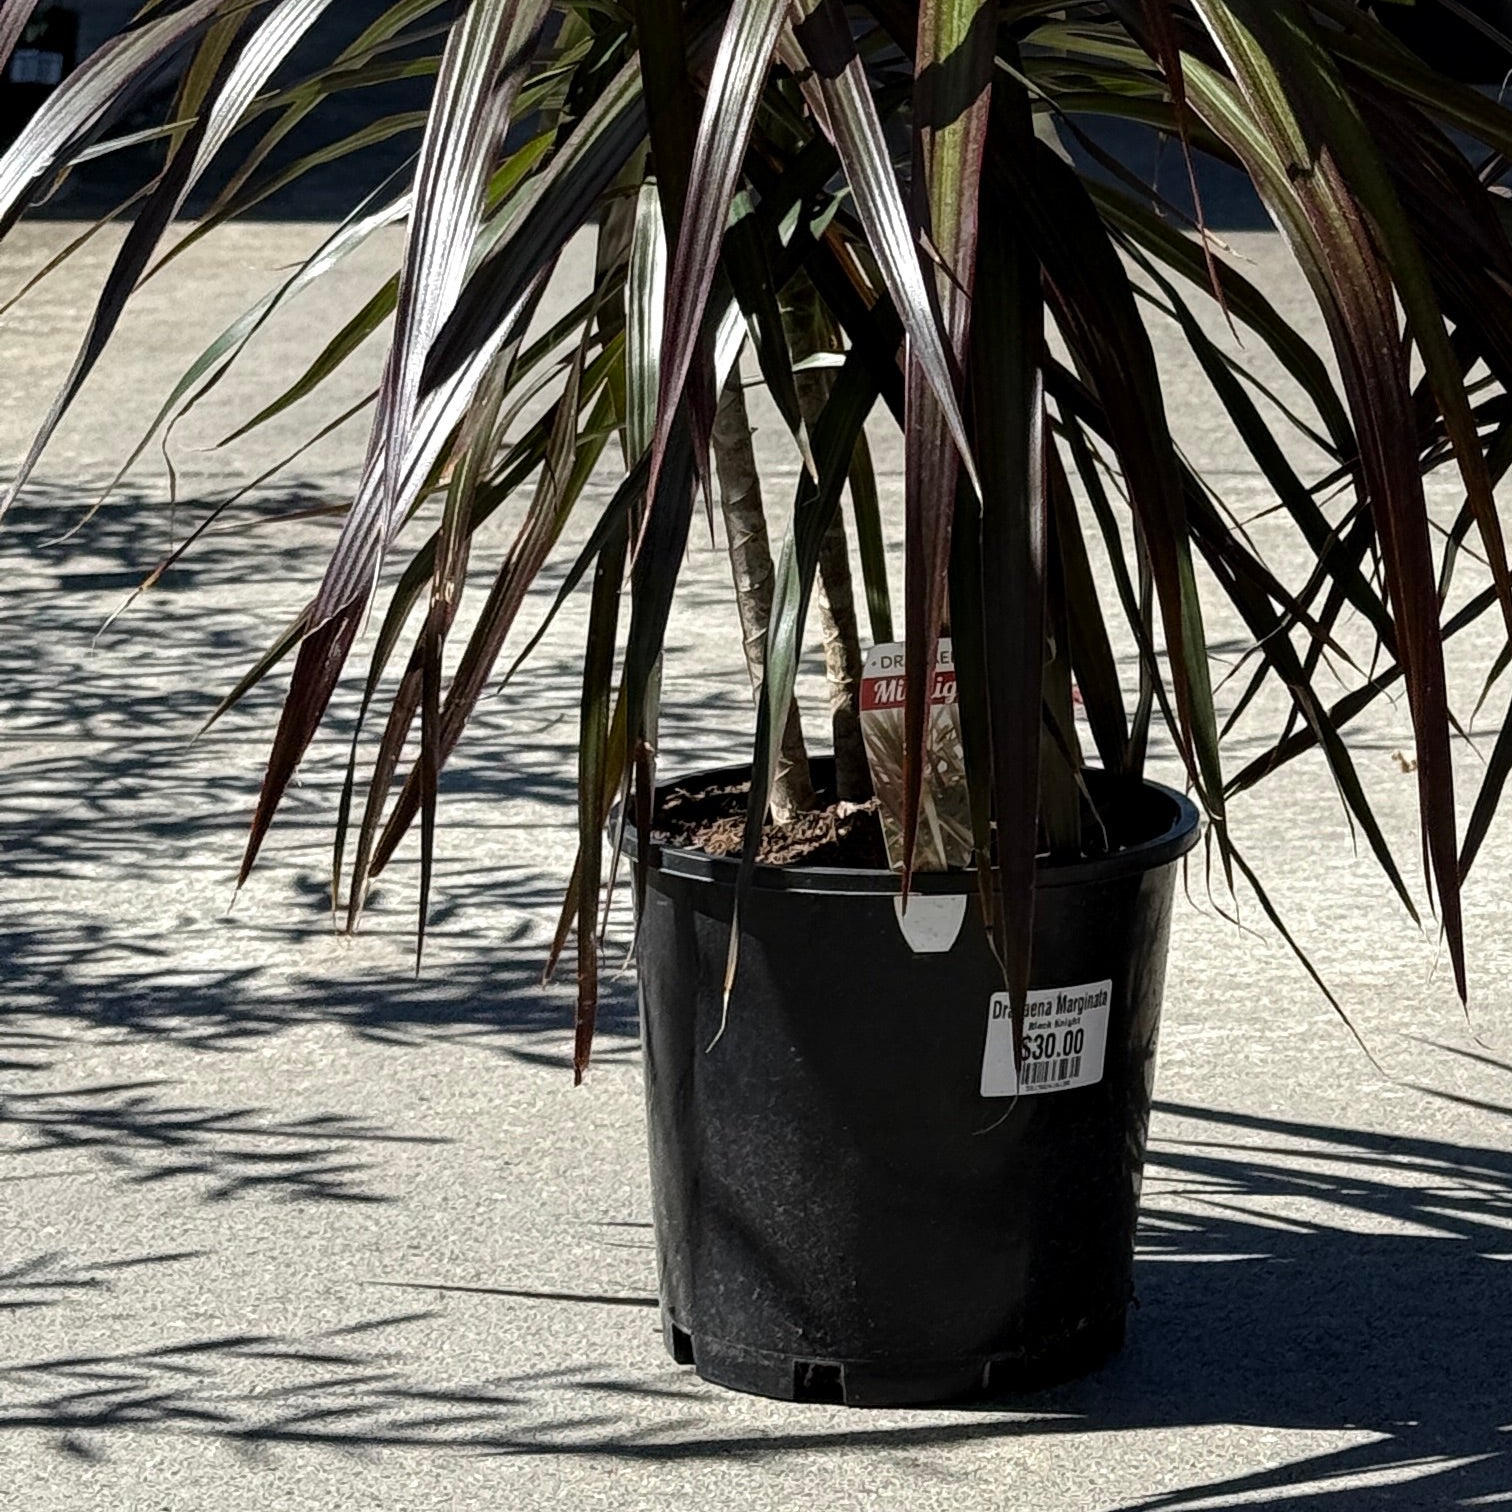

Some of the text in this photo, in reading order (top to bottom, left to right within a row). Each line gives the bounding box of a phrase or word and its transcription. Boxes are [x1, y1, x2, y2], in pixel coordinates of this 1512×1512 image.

[992, 989, 1108, 1019] Draaena Marginata
[1054, 1017, 1081, 1028] Knight
[1021, 1028, 1084, 1061] $30.00
